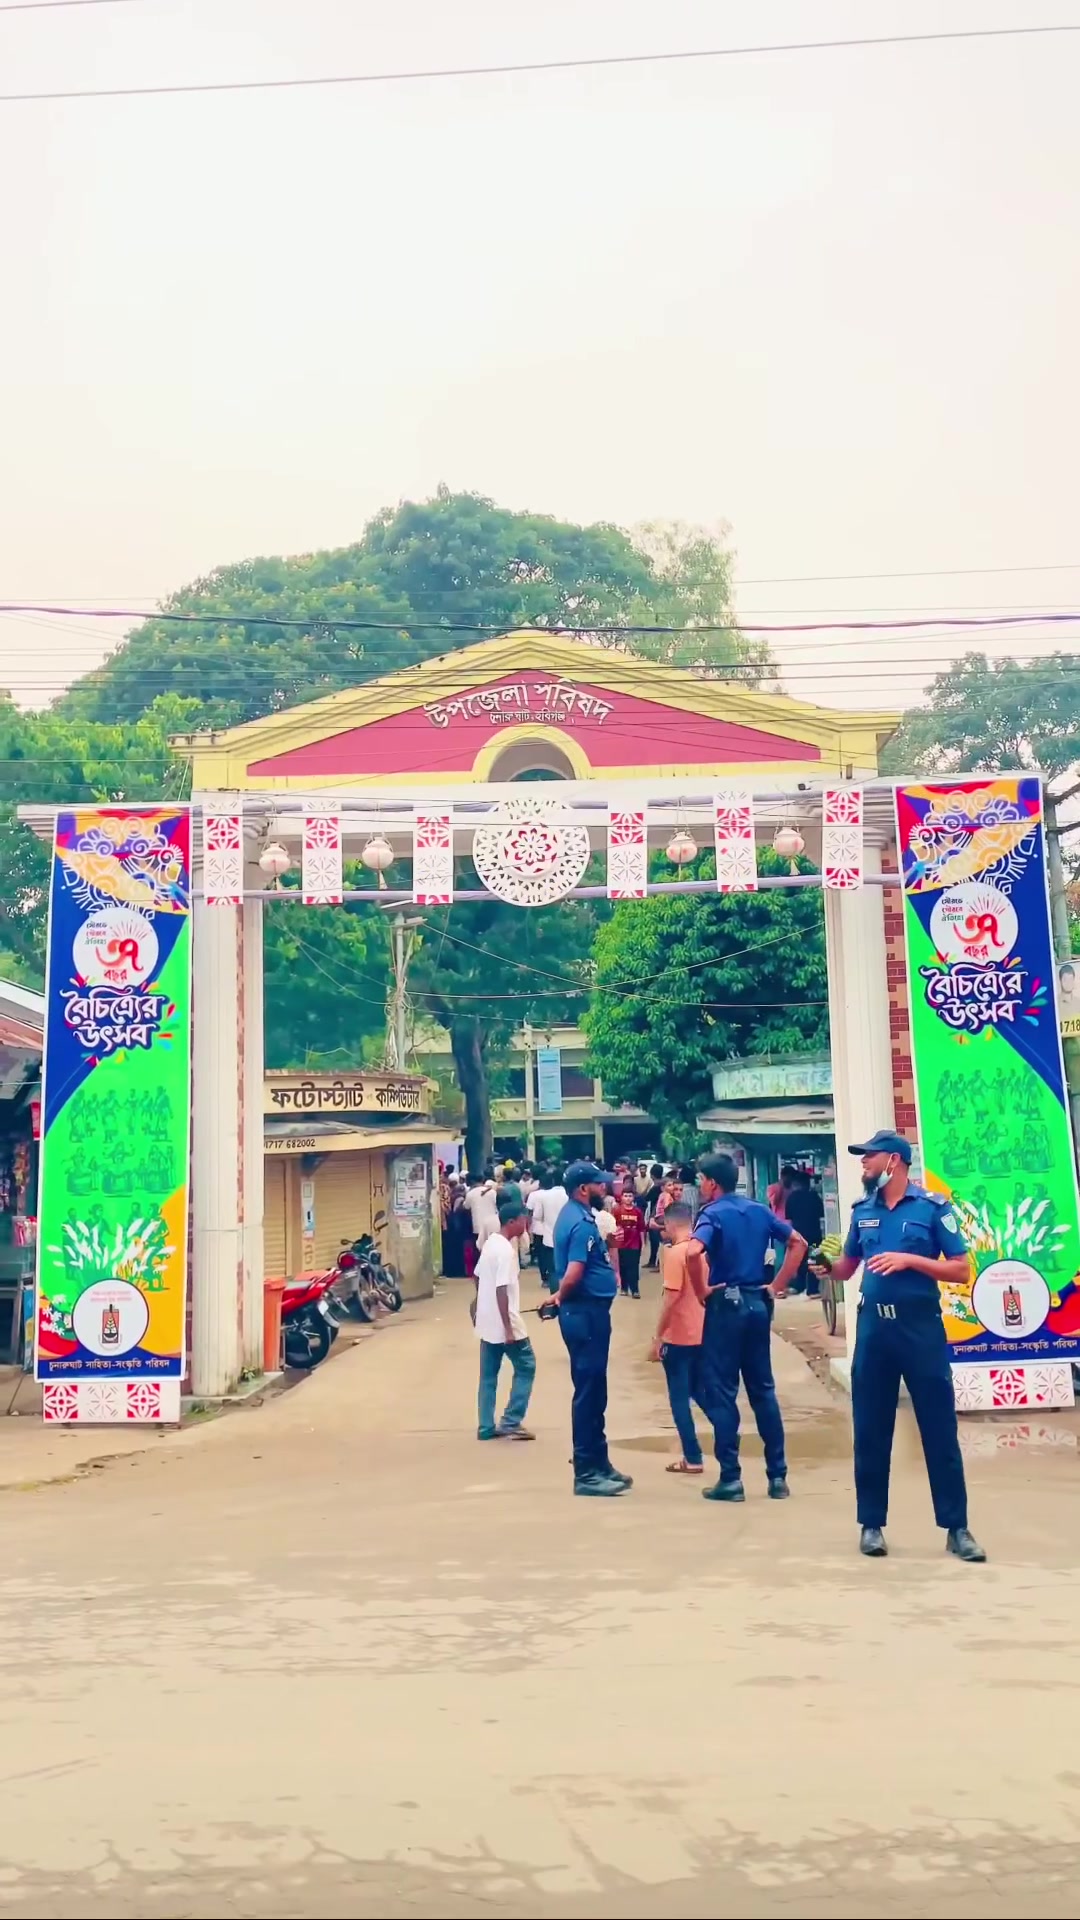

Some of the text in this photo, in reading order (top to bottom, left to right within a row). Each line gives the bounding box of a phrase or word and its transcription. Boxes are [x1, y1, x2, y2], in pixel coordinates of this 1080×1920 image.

[423, 677, 615, 728] উপজেলা পরিষদ
[964, 945, 990, 959] বছর
[104, 968, 128, 983] বছর
[920, 963, 1028, 1002] বৈচিত্র্যের
[60, 987, 165, 1025] বৈচিত্র্যের
[938, 1000, 1022, 1030] উৎসব
[73, 1021, 156, 1052] উৎসব
[270, 1080, 364, 1109] ফটোস্ট্যাট
[264, 1138, 316, 1149] 1717 682002
[952, 1343, 988, 1355] চুনারুঘাট
[1052, 1337, 1078, 1348] পরিষদ
[49, 1360, 82, 1372] চুনারুঘাট
[145, 1357, 170, 1368] পরিষদ
